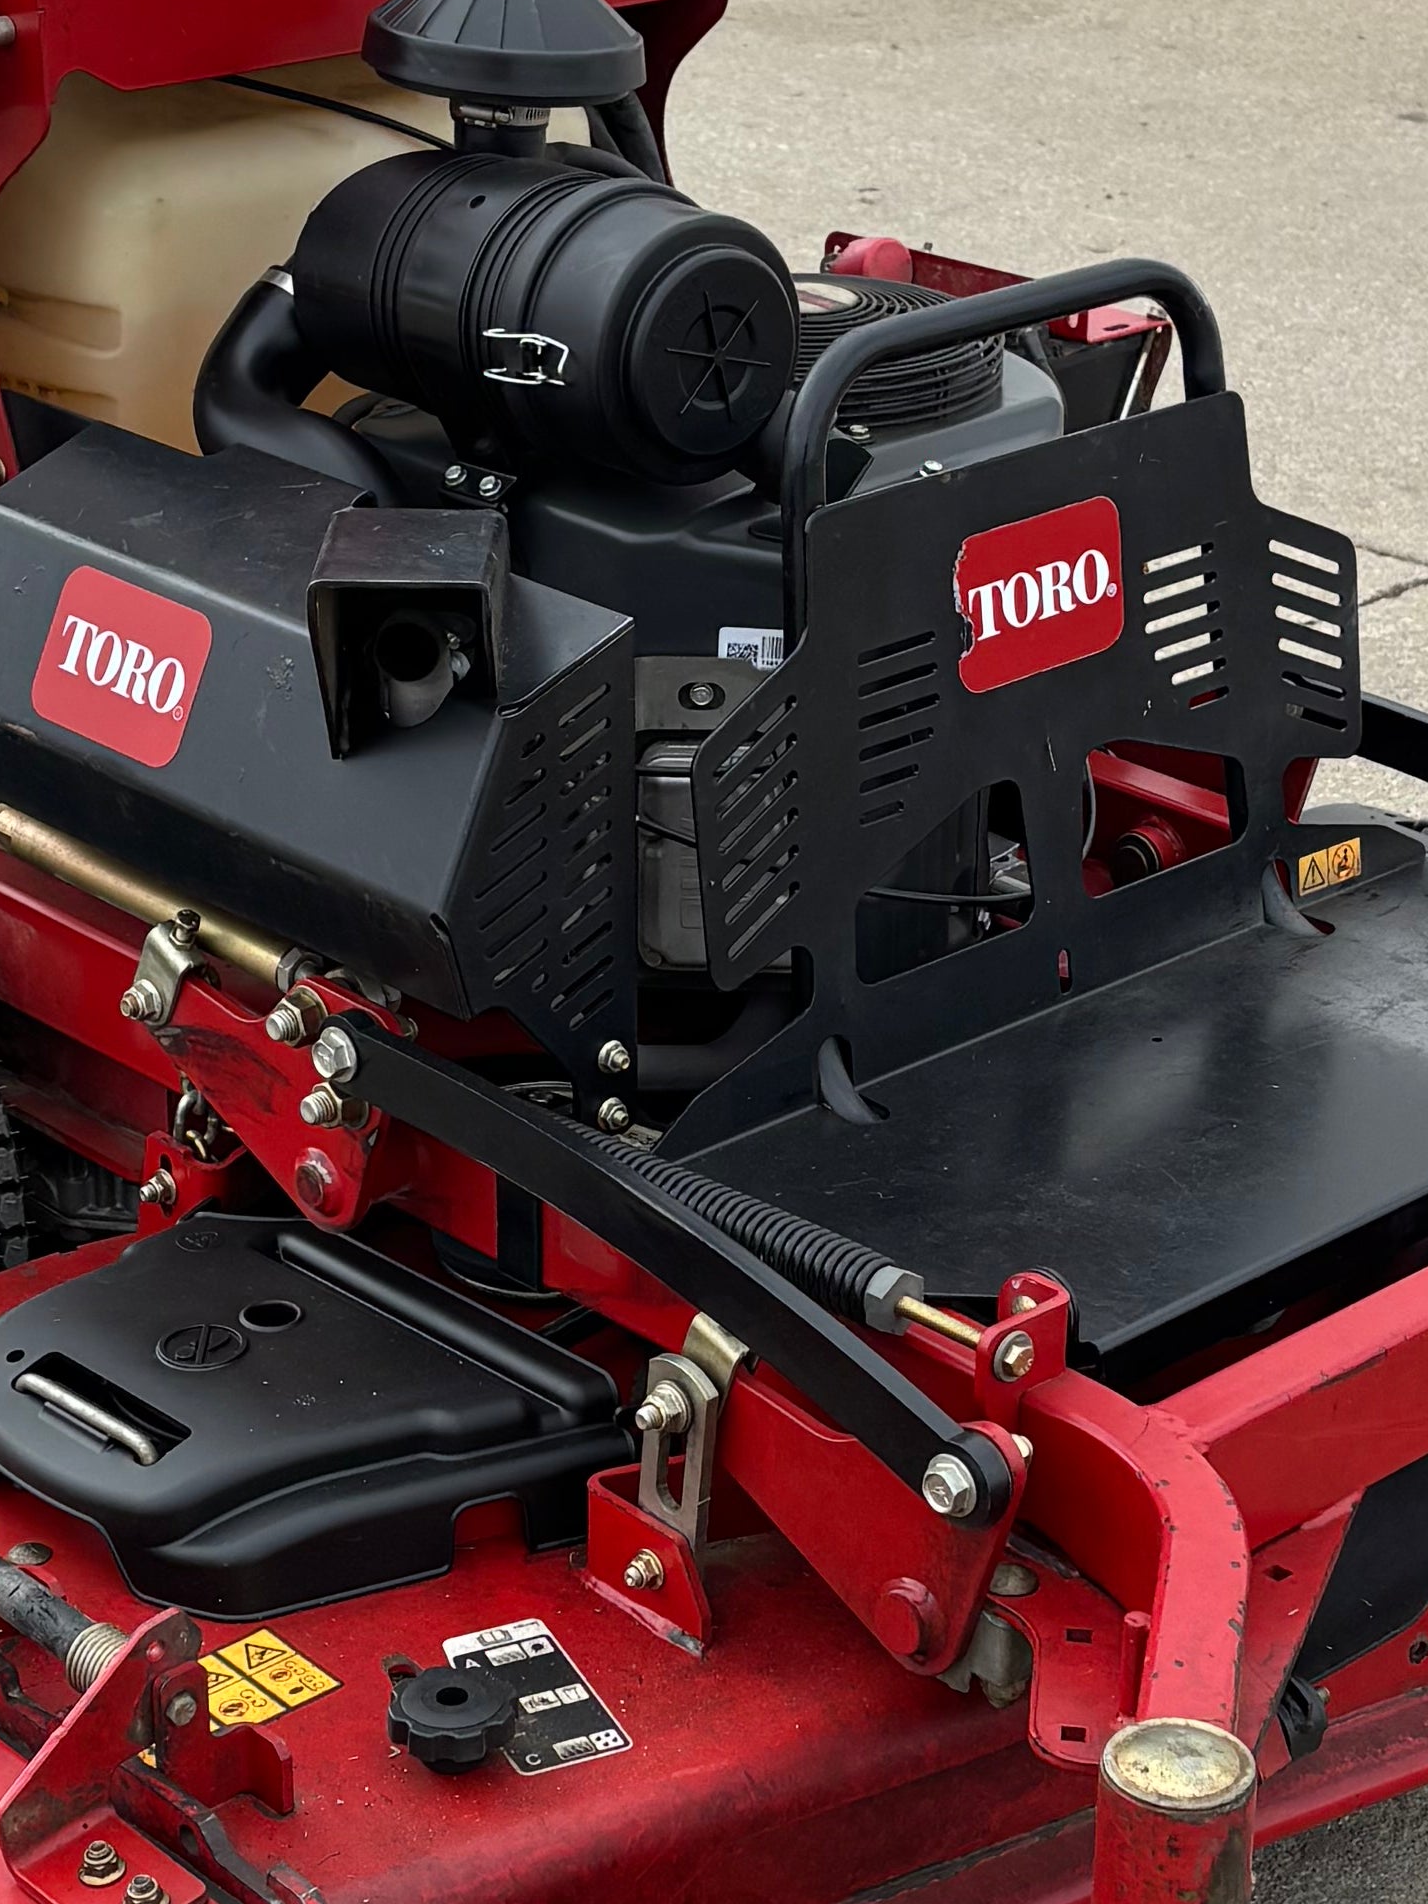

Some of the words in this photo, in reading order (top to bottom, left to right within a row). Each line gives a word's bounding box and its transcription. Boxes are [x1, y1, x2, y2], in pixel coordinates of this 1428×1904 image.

[968, 549, 1110, 642] TORO
[57, 614, 186, 714] TORO
[525, 1753, 542, 1765] C
